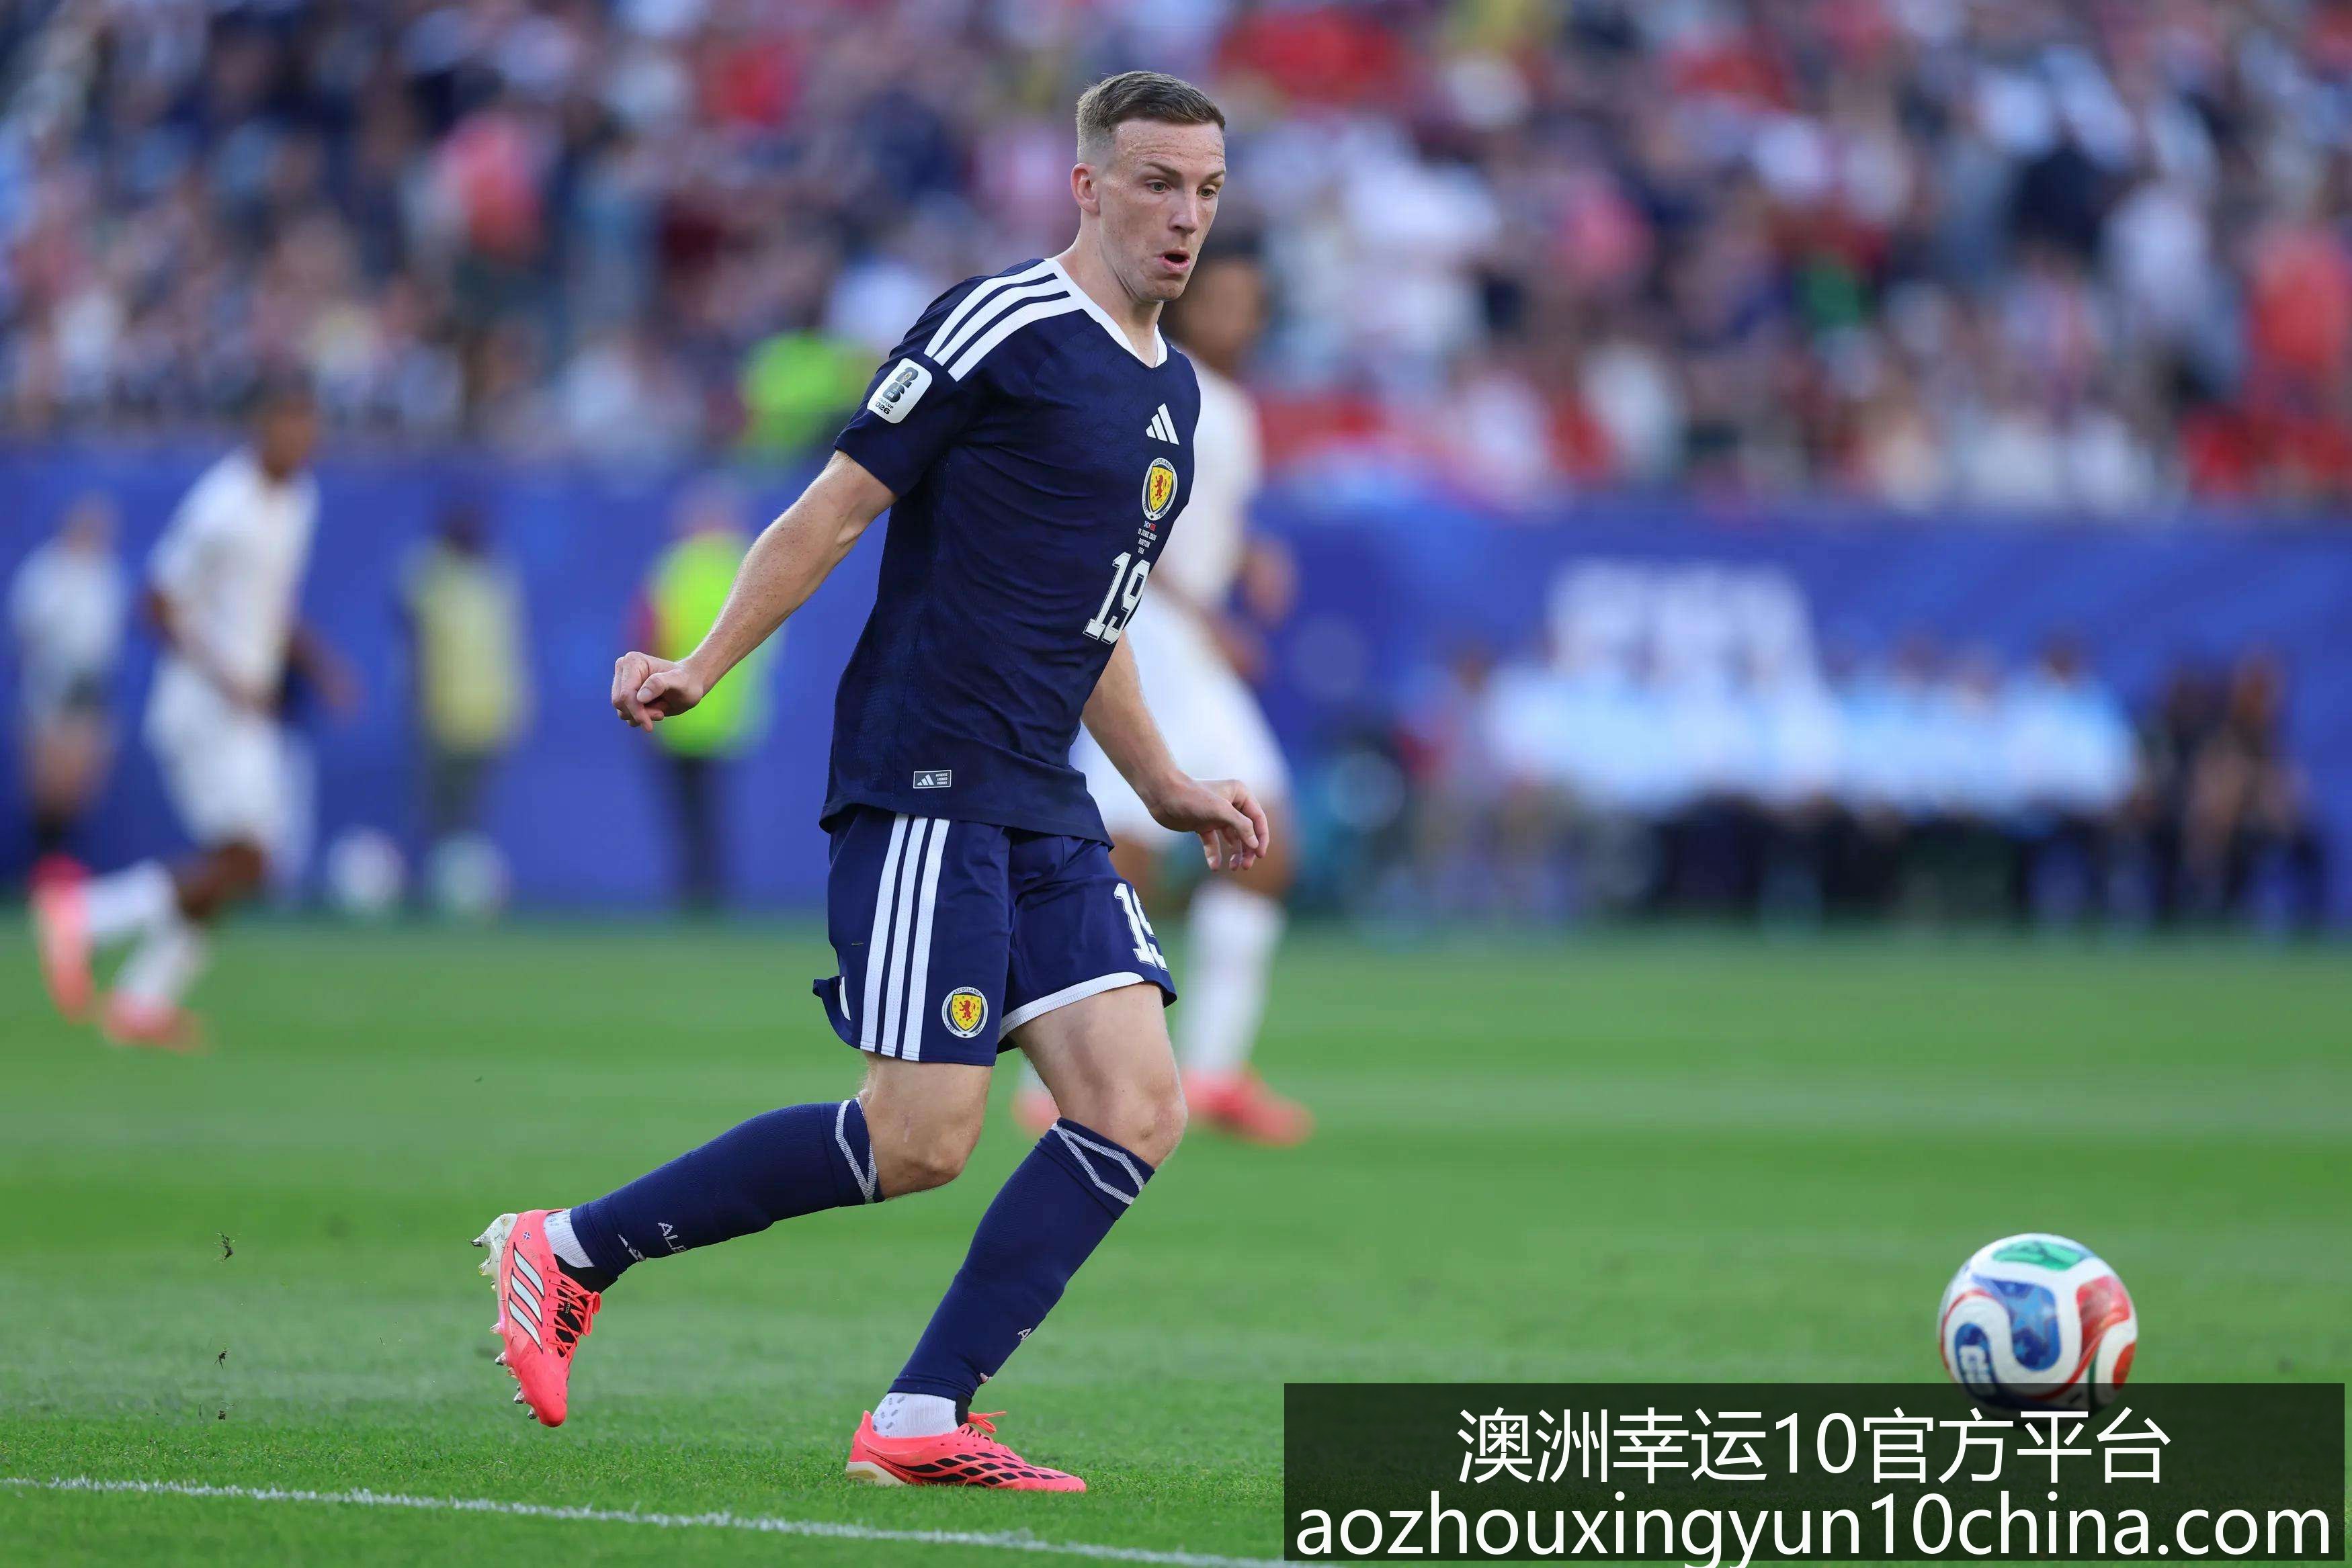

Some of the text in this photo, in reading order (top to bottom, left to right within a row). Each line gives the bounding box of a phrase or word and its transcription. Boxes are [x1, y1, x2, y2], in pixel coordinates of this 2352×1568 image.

[1154, 458, 1172, 470] SCOTLAND
[1082, 551, 1150, 645] 19
[955, 987, 980, 995] SCOTLAND
